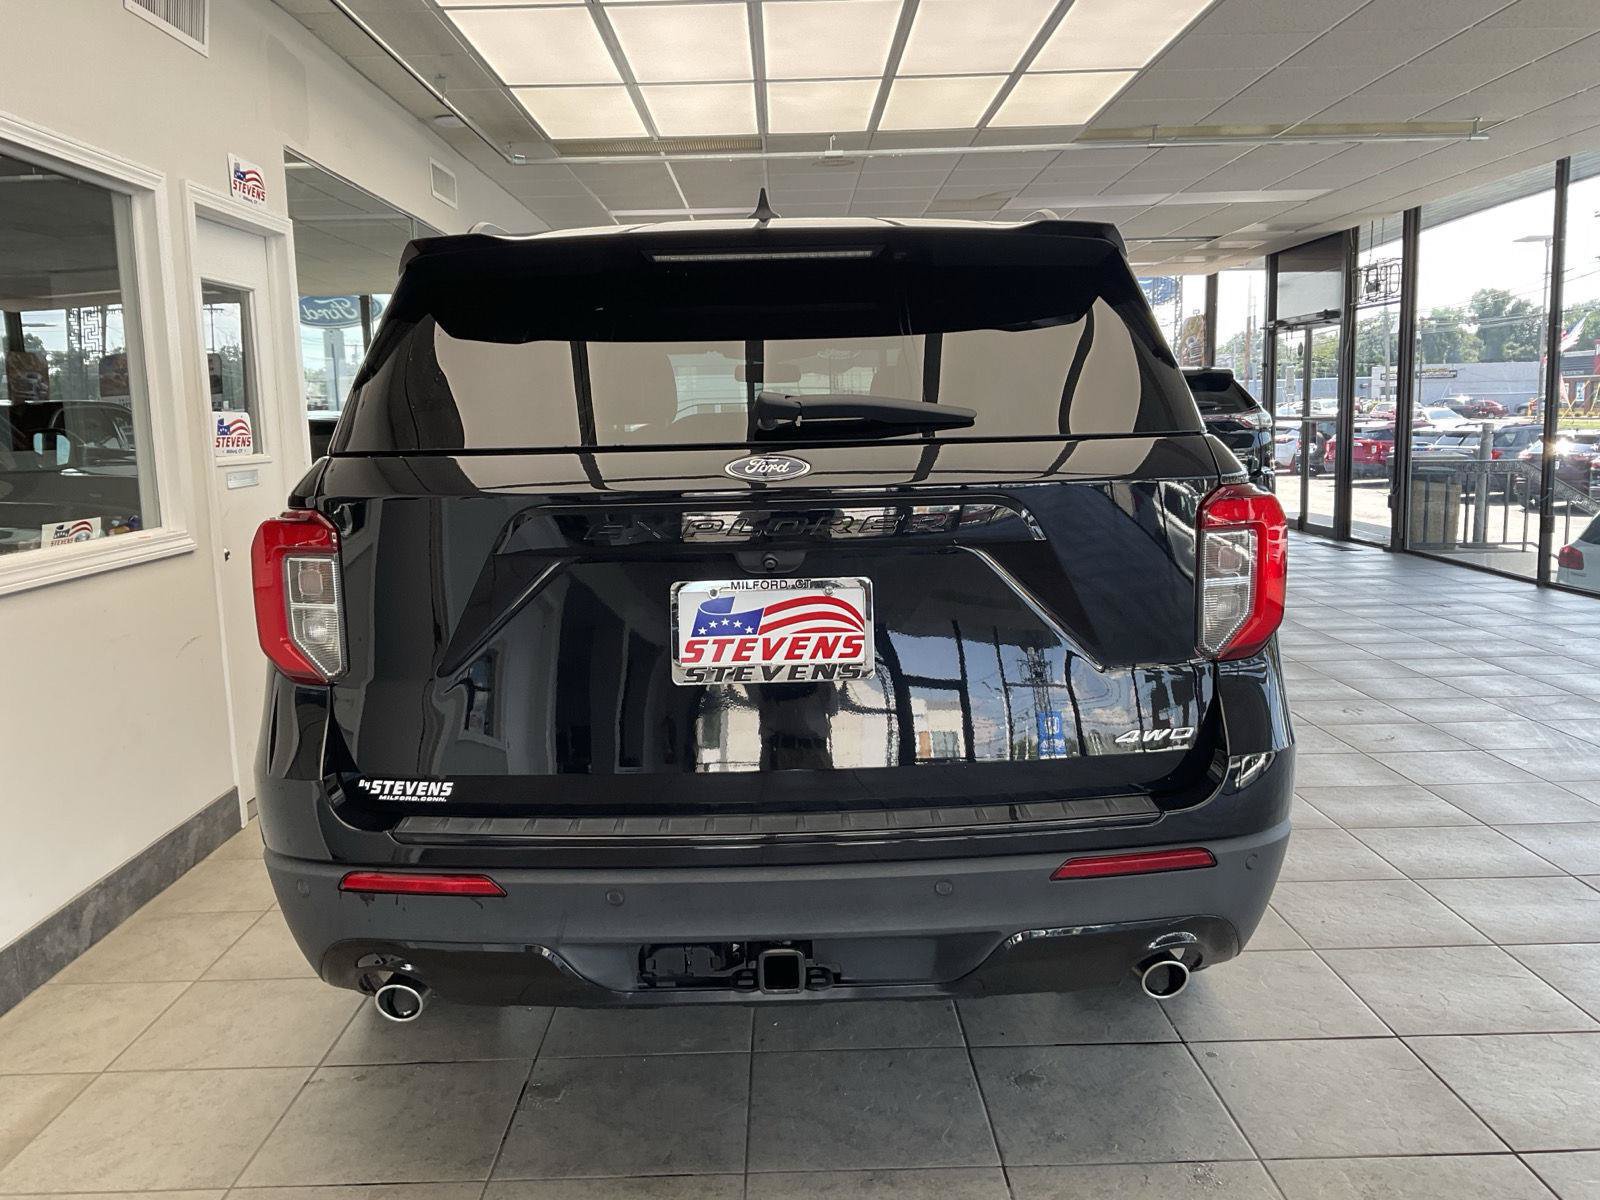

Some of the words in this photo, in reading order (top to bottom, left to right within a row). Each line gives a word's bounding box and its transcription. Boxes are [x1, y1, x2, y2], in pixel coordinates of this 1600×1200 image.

[233, 179, 266, 202] STEVENS
[215, 436, 251, 448] STEVENS
[745, 457, 790, 475] Ford
[584, 513, 949, 541] EXPLORER
[795, 578, 812, 589] CT
[681, 635, 865, 664] STEVENS
[684, 663, 864, 683] STEVENS
[1115, 727, 1195, 744] 4WD
[358, 779, 371, 790] By
[369, 780, 454, 796] STEVENS
